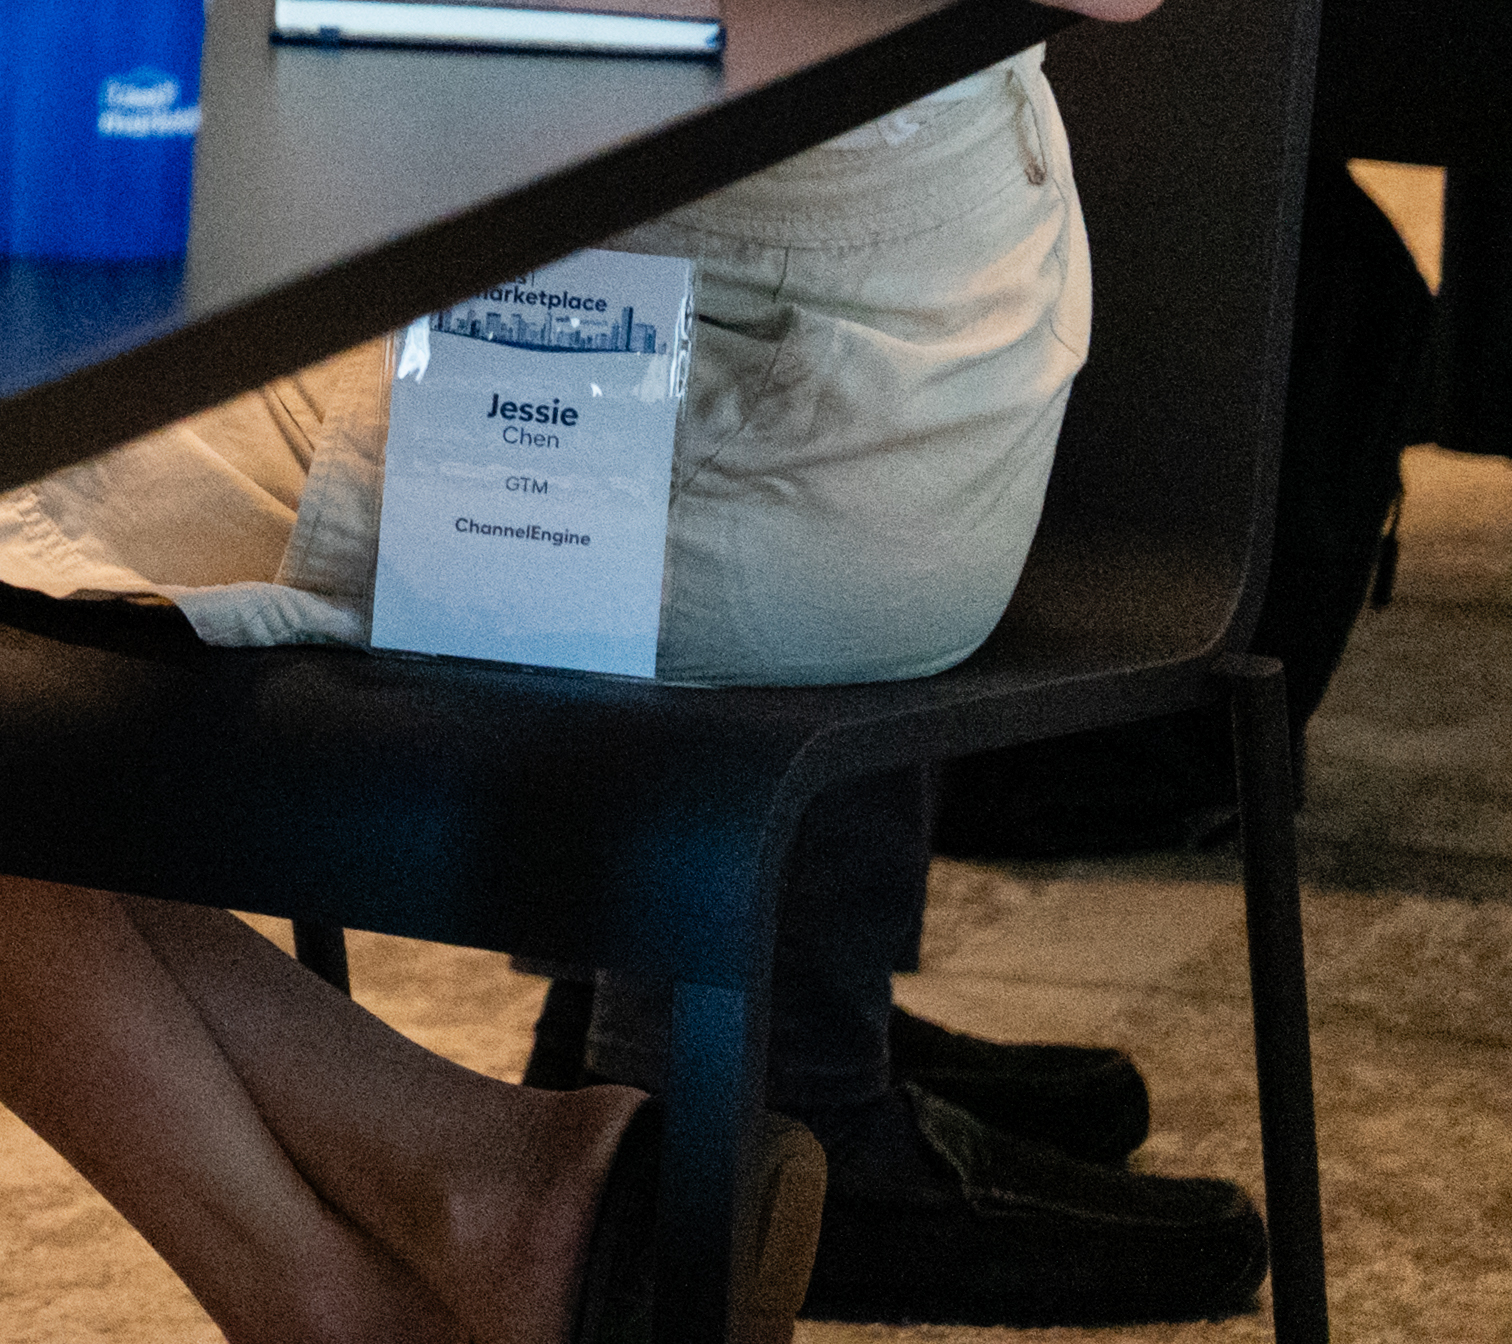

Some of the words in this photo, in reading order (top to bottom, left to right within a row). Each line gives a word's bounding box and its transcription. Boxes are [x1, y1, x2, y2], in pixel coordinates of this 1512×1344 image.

[486, 393, 579, 427] Jessie
[502, 425, 560, 449] Chen
[505, 475, 549, 495] GTM
[455, 517, 592, 547] ChannelEngine
